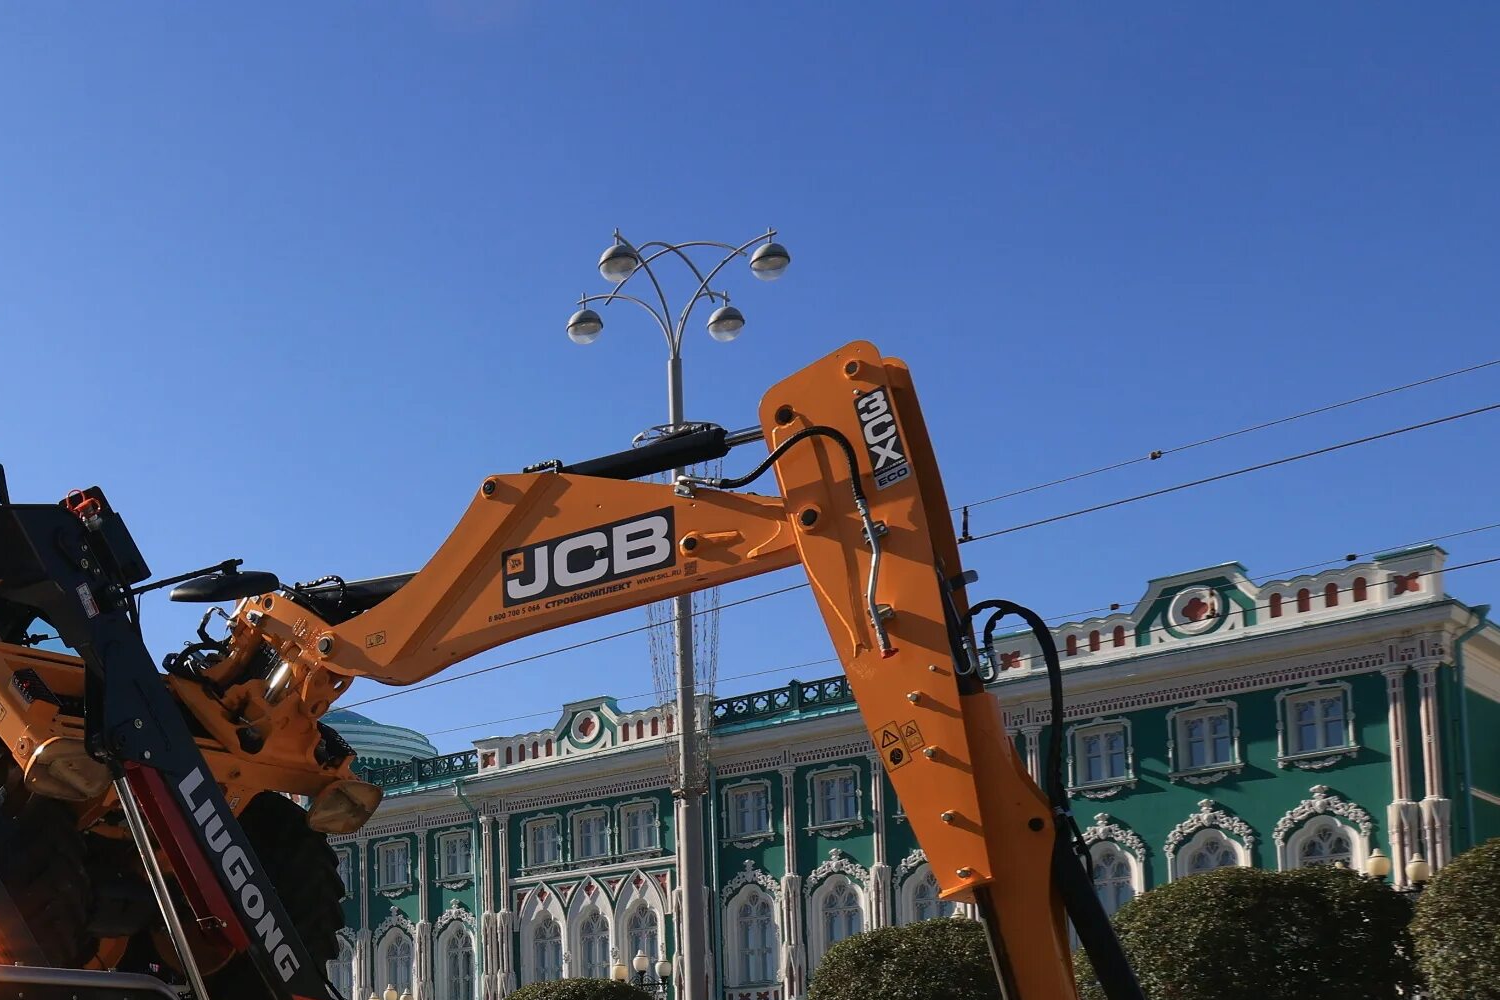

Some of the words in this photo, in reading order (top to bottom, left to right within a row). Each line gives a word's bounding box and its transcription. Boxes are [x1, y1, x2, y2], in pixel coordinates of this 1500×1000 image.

[857, 390, 904, 471] 3CX
[878, 466, 909, 487] ECO
[507, 515, 671, 599] JCB
[494, 612, 506, 621] 800
[508, 608, 520, 617] 700
[545, 581, 632, 609] СТРОЙКОМПЛЕКТ
[178, 766, 301, 984] LIUGONG
